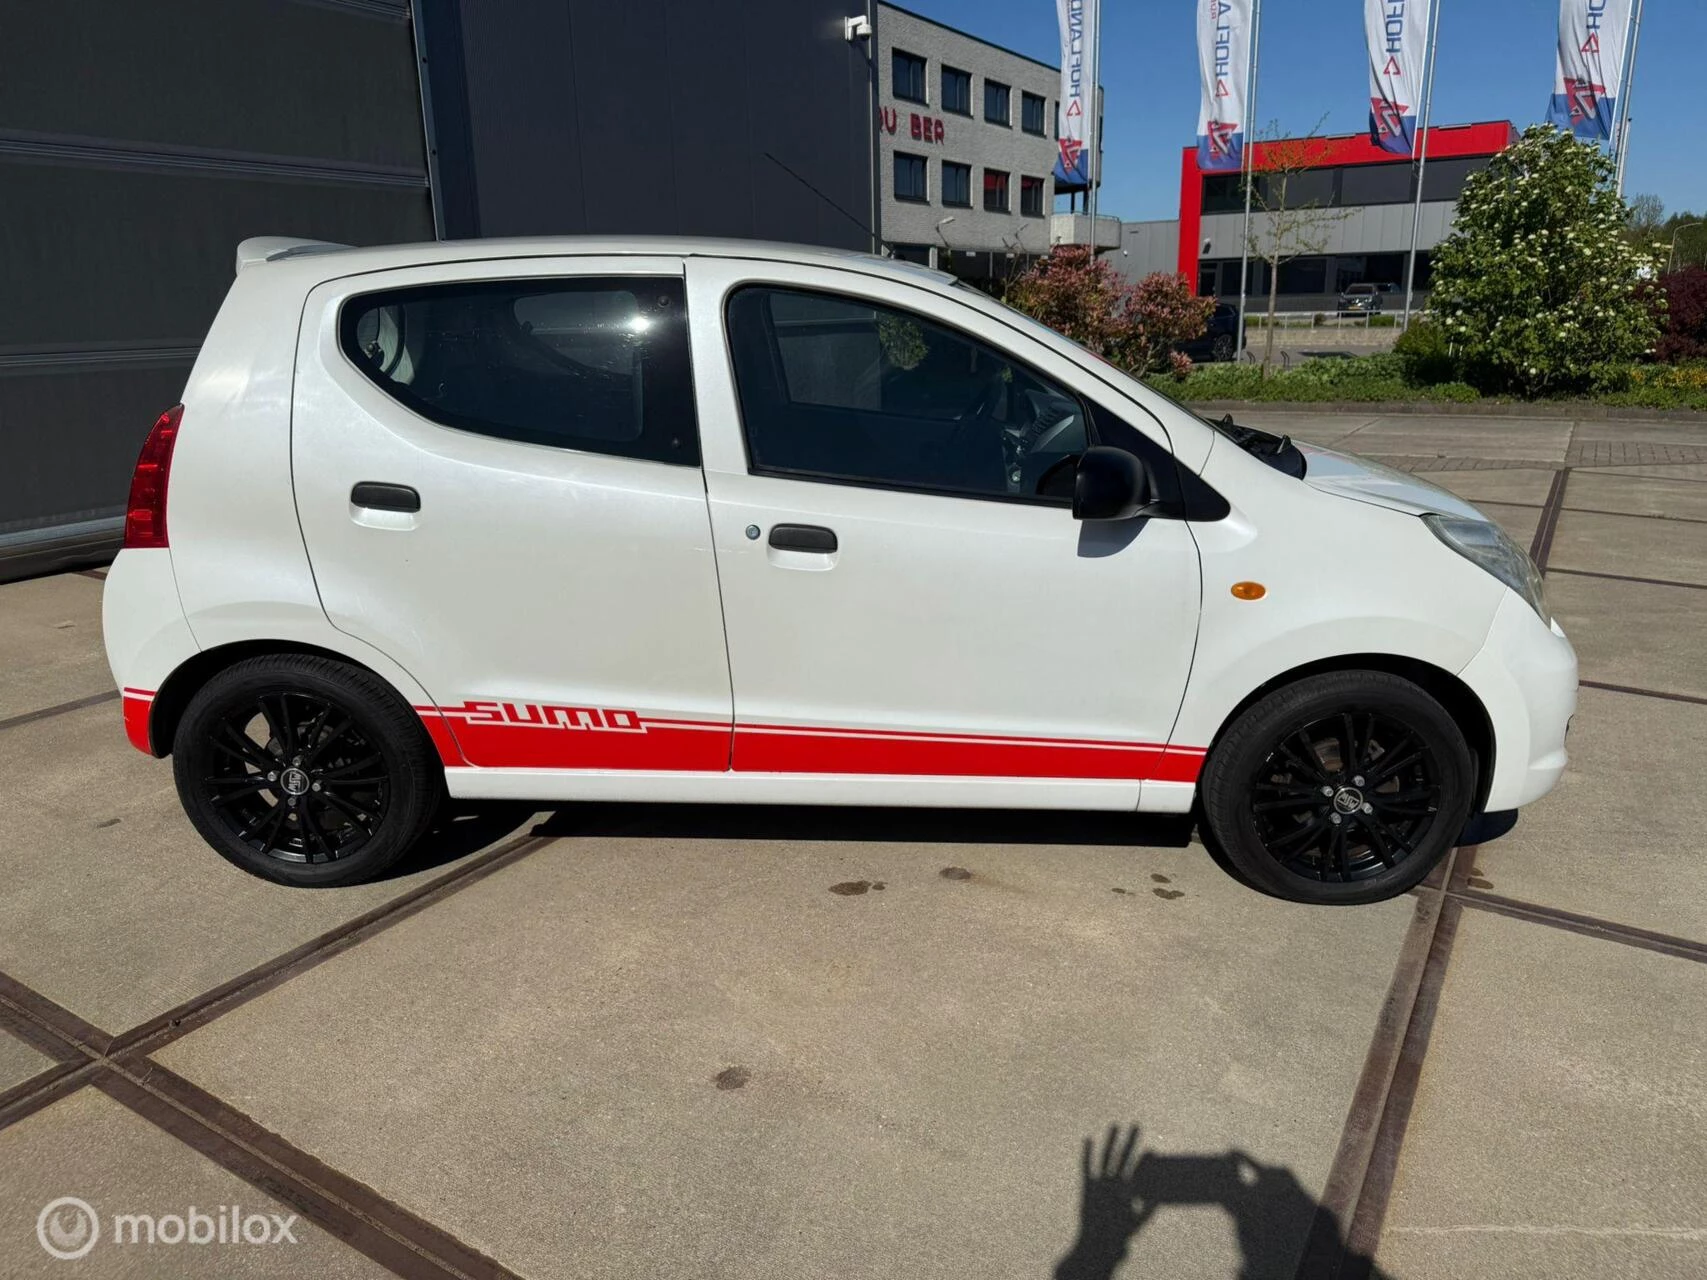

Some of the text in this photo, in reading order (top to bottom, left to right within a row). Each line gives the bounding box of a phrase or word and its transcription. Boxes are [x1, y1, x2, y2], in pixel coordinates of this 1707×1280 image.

[879, 106, 945, 145] U BER
[463, 701, 644, 730] SUMO
